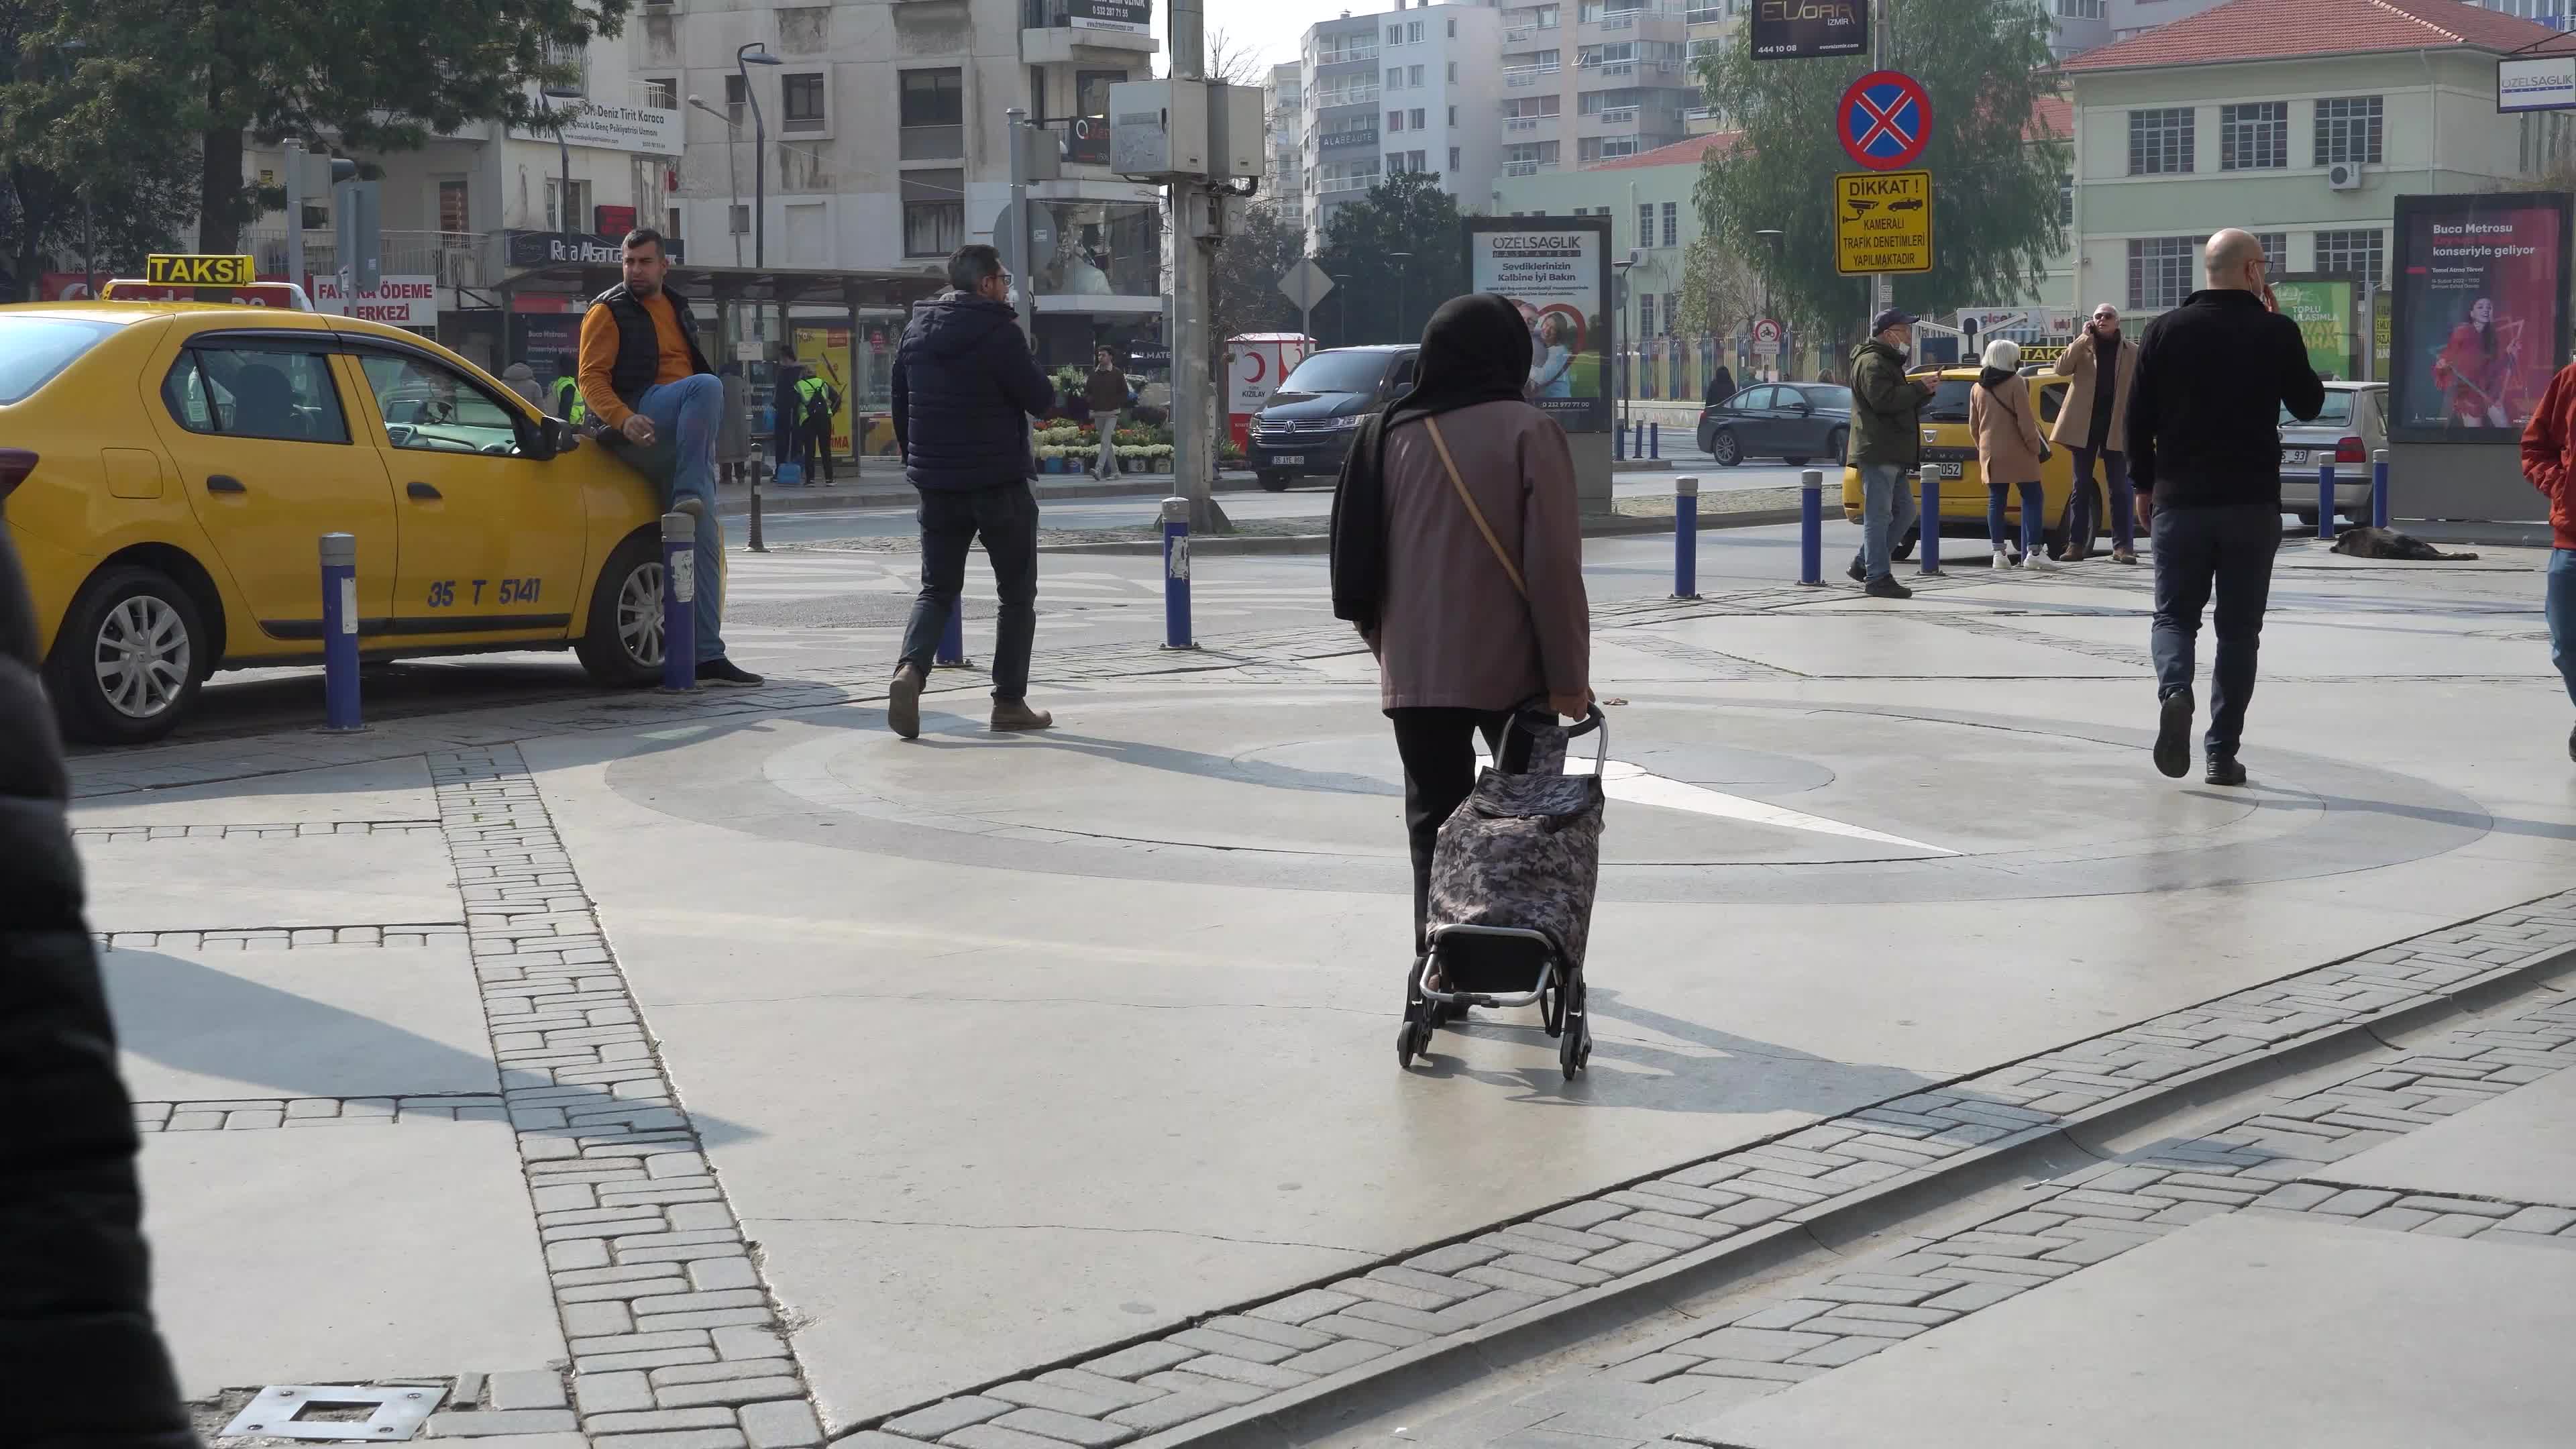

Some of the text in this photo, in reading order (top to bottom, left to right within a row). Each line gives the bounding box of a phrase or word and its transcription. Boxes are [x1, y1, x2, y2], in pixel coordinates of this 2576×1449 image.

[1097, 6, 1106, 15] 532
[1827, 17, 1849, 26] İZMİR
[597, 105, 619, 119] Deniz
[620, 107, 637, 121] Tirit
[638, 109, 665, 124] Karaca
[595, 122, 609, 134] Genç
[1849, 179, 1919, 196] DİKKAT !
[1864, 217, 1904, 231] KAMERALI
[2433, 223, 2513, 234] Buca Metrosu
[1843, 233, 1925, 250] TRAFİK DENETİMLERİ
[2432, 245, 2535, 258] konseriyle geliyor
[1854, 253, 1915, 266] YAPILMAKTADIR
[1502, 262, 1571, 271] Sevdiklerinizin
[1498, 272, 1576, 282] Kalbine İyi Bakın
[380, 280, 433, 299] ÖDEME
[2292, 305, 2321, 313] TOPLU
[2294, 451, 2305, 460] 93
[427, 578, 541, 608] 35 T 5141
